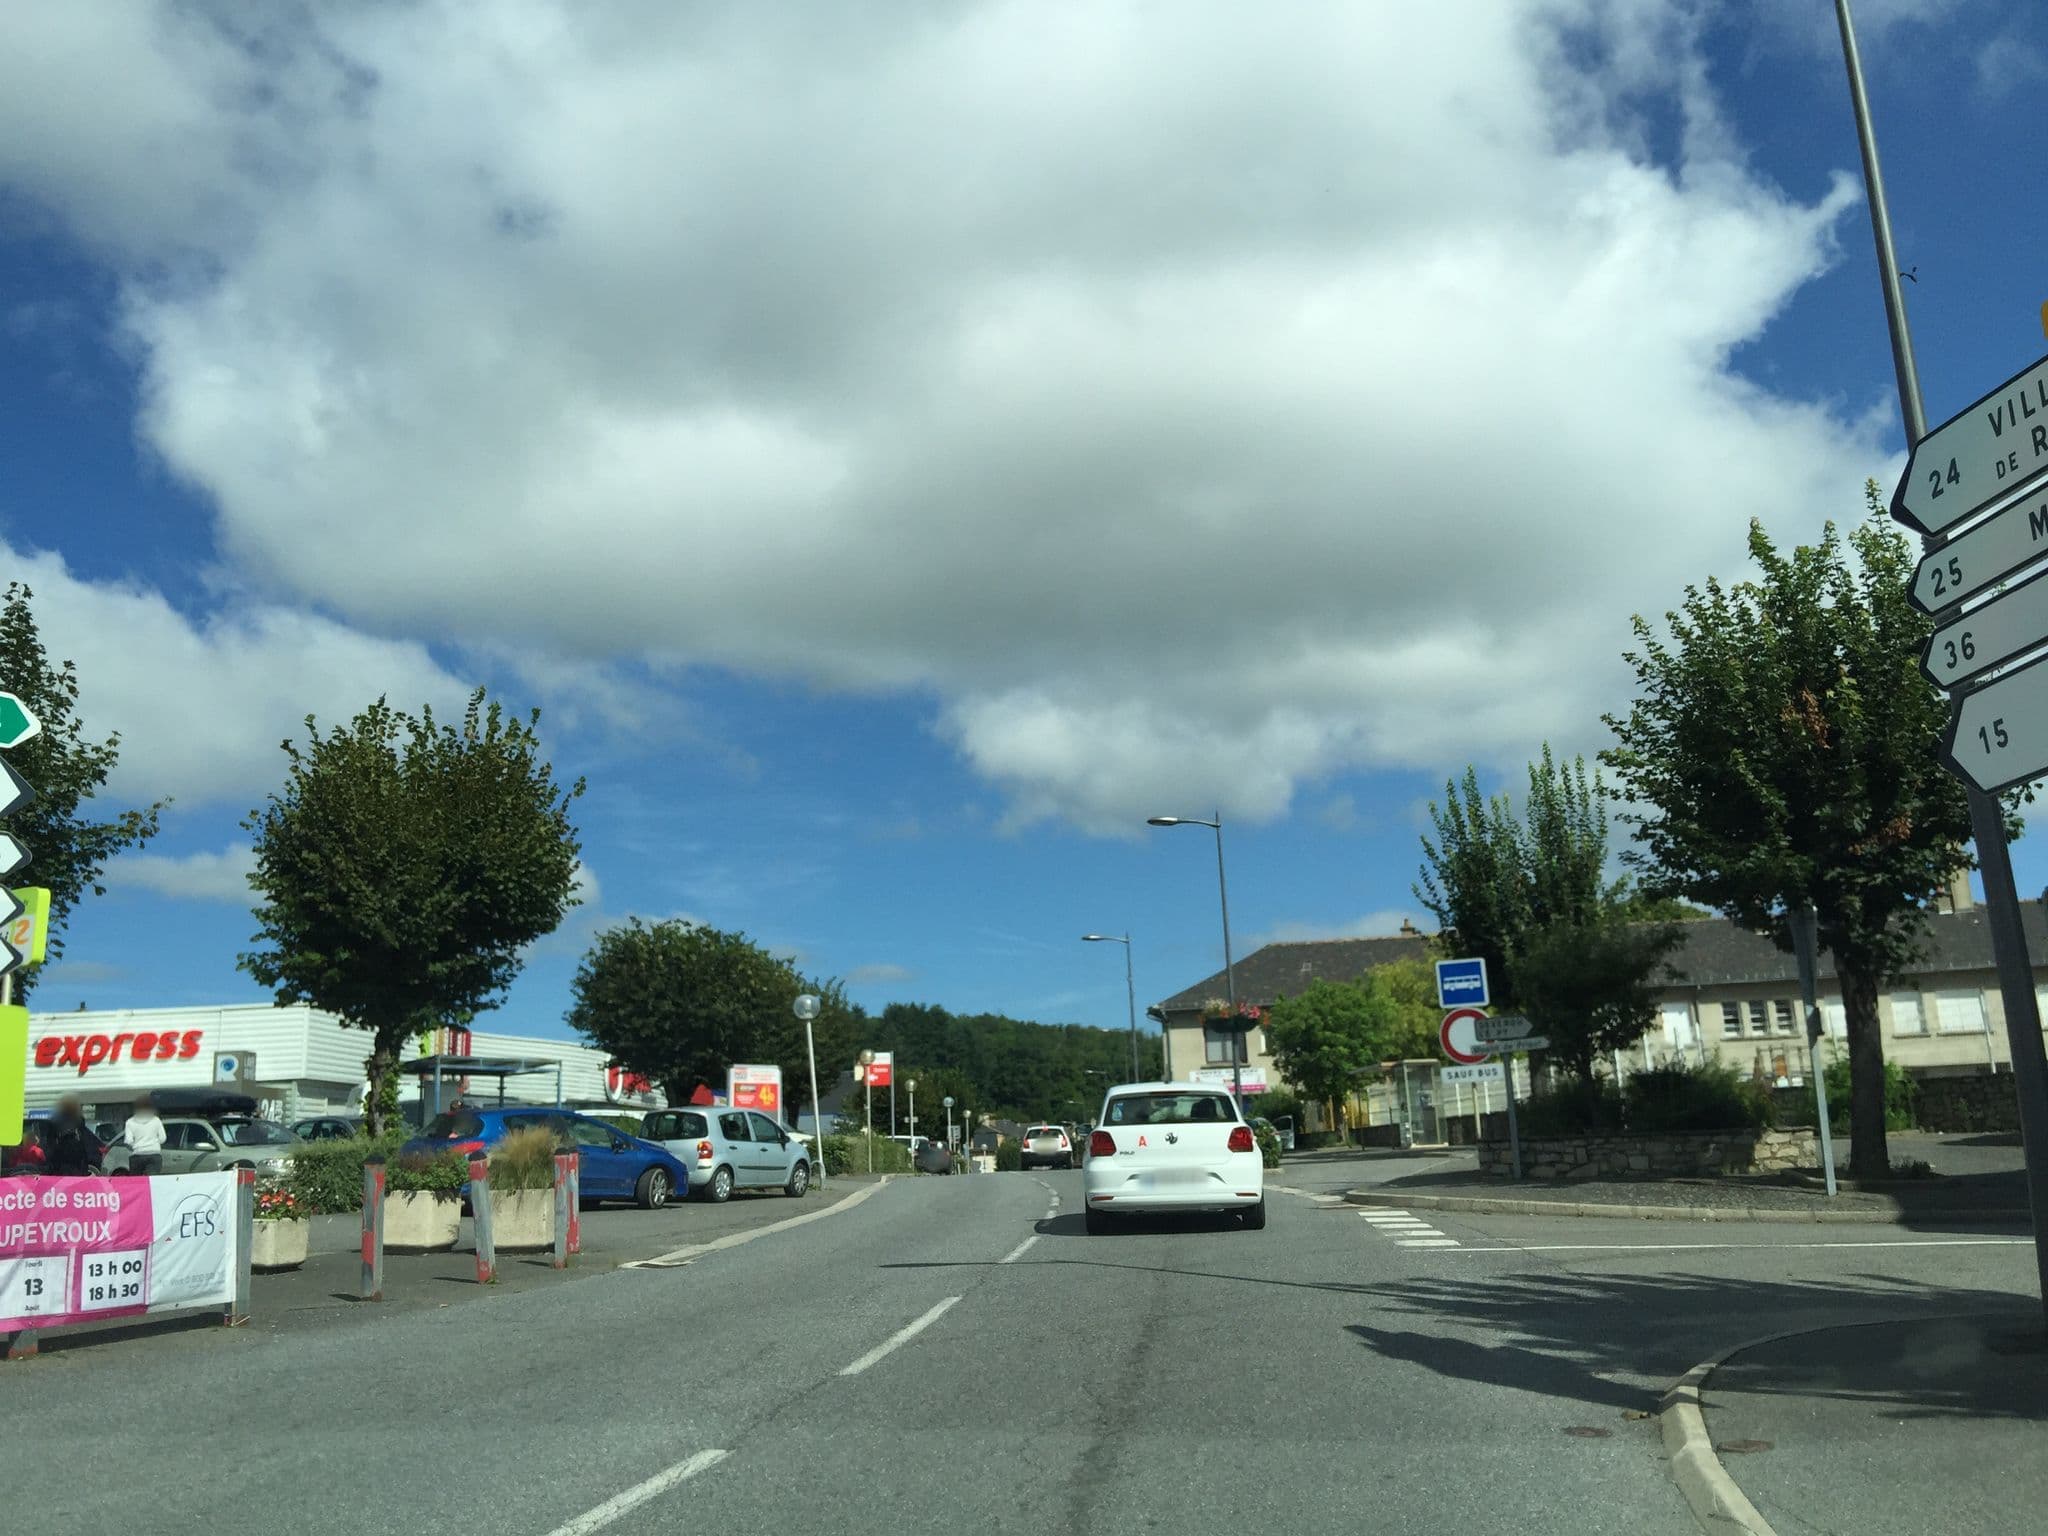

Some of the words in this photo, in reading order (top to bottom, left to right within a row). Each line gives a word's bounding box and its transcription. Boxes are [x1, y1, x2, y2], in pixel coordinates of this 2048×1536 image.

[1928, 457, 1961, 500] 24
[1995, 451, 2019, 480] DE
[1930, 556, 1963, 598] 25
[1943, 631, 1976, 670] 36
[1978, 717, 2009, 755] 15
[35, 1030, 203, 1077] express
[1446, 1069, 1474, 1081] SAUF
[1477, 1067, 1498, 1078] BUS
[1138, 1135, 1148, 1147] A
[0, 1189, 36, 1211] cte
[43, 1187, 67, 1209] de
[73, 1190, 120, 1213] sang
[179, 1209, 216, 1239] EFS
[88, 1263, 103, 1277] 13
[108, 1261, 117, 1275] h
[122, 1260, 142, 1274] 00
[24, 1278, 43, 1296] 13
[89, 1286, 104, 1301] 18
[108, 1284, 117, 1298] h
[121, 1283, 139, 1296] 30
